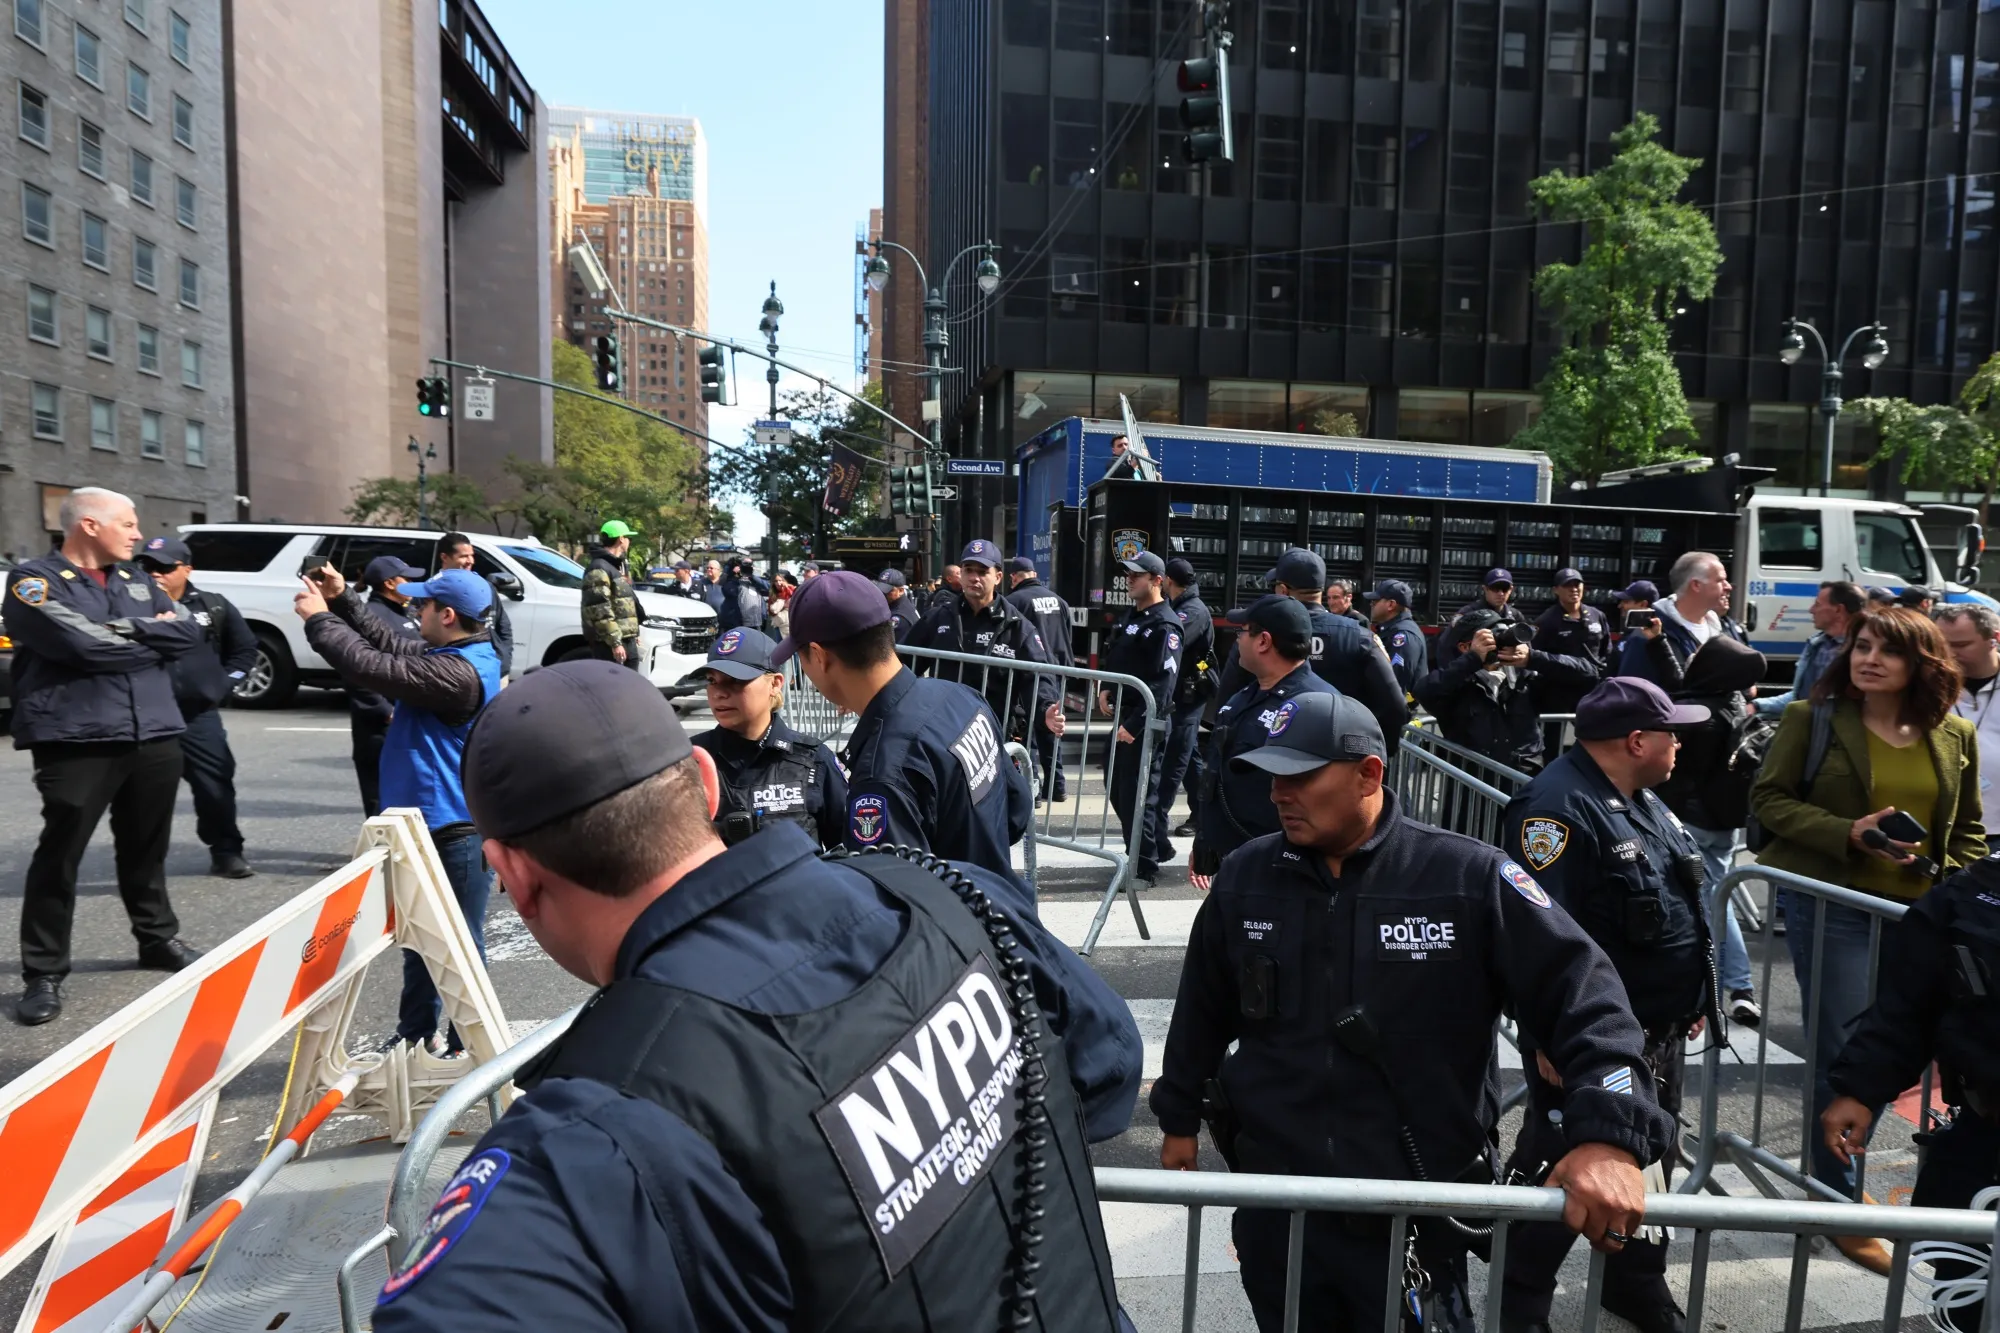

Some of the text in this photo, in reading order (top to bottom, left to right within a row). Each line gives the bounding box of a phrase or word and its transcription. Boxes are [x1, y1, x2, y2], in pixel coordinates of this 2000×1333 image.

[613, 121, 696, 144] TUDOR
[625, 149, 683, 172] CITY
[951, 462, 1001, 472] Second Ave
[1115, 535, 1146, 543] DEPARTMENT
[1749, 581, 1767, 595] 858
[1032, 597, 1058, 608] NYPD
[993, 644, 1016, 656] POLICE
[955, 713, 995, 778] NYPD
[753, 787, 802, 803] POLICE
[855, 797, 882, 810] POLICE
[1534, 821, 1557, 830] POLICE
[1526, 826, 1564, 839] DEPARTMENT
[1541, 854, 1553, 864] NEW
[1552, 841, 1564, 855] YORK
[1611, 842, 1636, 853] LICATA
[1282, 851, 1301, 861] DCU
[1620, 850, 1635, 859] 6437
[1243, 920, 1273, 931] DELGADO
[1380, 922, 1455, 942] POLICE
[1385, 941, 1452, 950] DISORDER CONTROL
[1411, 952, 1428, 960] UNIT
[838, 972, 1013, 1194] NYPD
[953, 1112, 1002, 1186] GROUP
[875, 1117, 972, 1234] STRATEGIC
